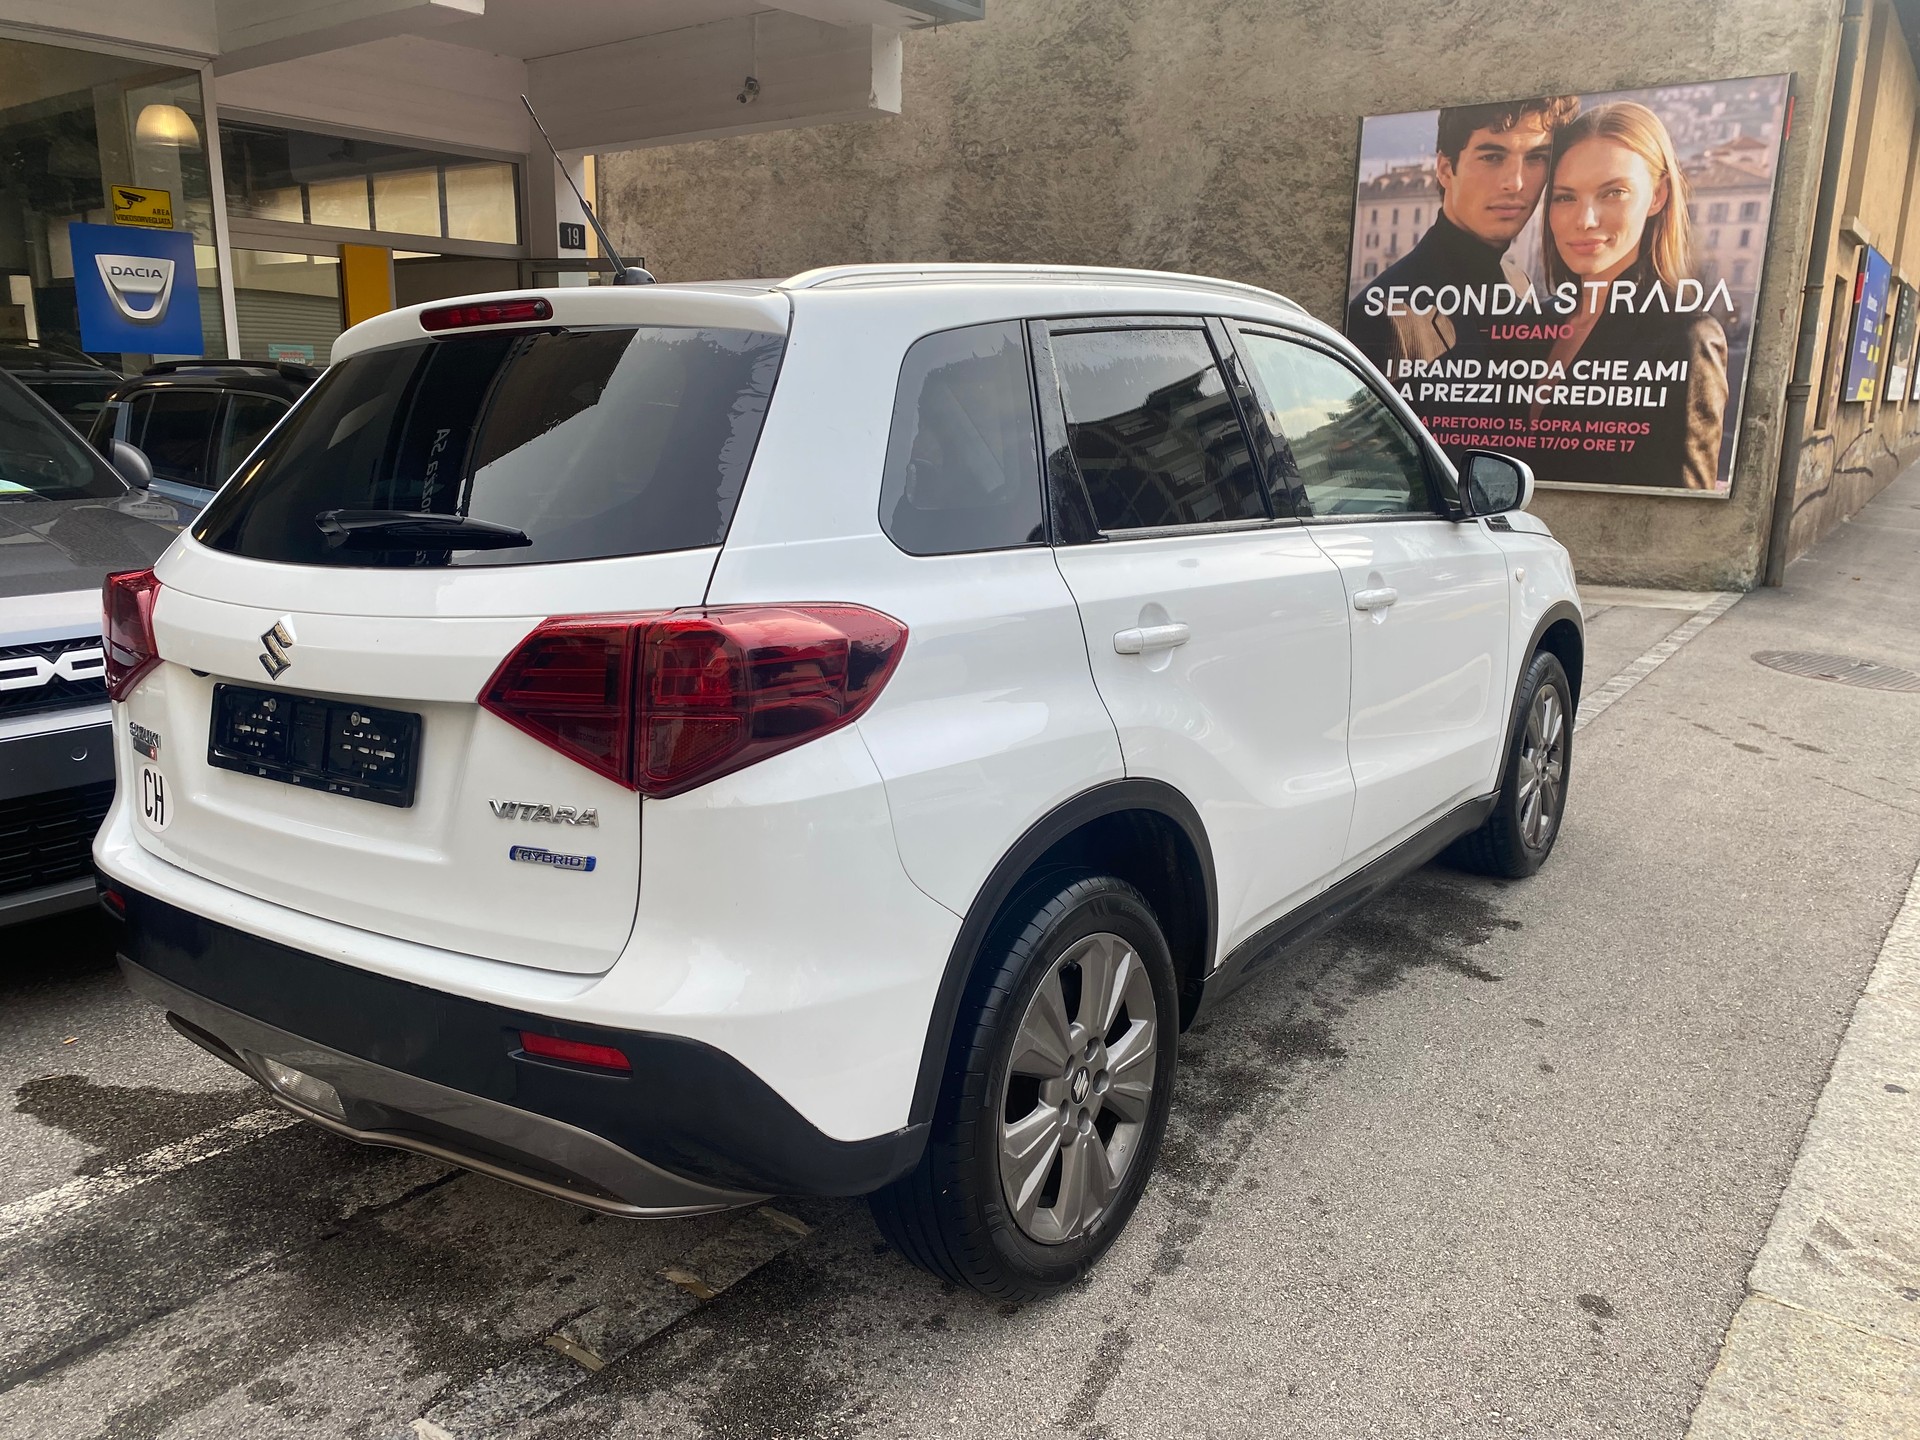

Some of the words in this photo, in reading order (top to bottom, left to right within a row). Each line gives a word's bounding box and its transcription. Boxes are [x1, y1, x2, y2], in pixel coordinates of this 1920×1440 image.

[153, 208, 170, 216] AREA
[567, 227, 580, 246] 19
[110, 266, 163, 279] DACIA
[1364, 282, 1542, 317] SECONDA
[1554, 277, 1735, 315] STRADA
[1491, 324, 1575, 340] LUGANO
[1386, 358, 1393, 378] I
[1399, 359, 1482, 379] BRAND
[1487, 359, 1566, 380] MODA
[1572, 360, 1629, 381] CHE
[1633, 360, 1689, 382] AMI
[1399, 382, 1414, 401] A
[1419, 383, 1502, 404] PREZZI
[1507, 384, 1668, 408] INCREDIBILI
[1432, 415, 1505, 430] PRETORIO
[1508, 417, 1526, 432] 15,
[1530, 418, 1582, 433] SOPRA
[1585, 420, 1650, 435] MIGROS
[1431, 433, 1536, 449] AUGURAZIONE
[1539, 436, 1580, 451] 17/09
[1583, 439, 1617, 452] ORE
[1619, 440, 1636, 453] 17
[143, 768, 164, 826] CH
[488, 799, 600, 829] VITARA
[519, 848, 582, 867] HYBRID
